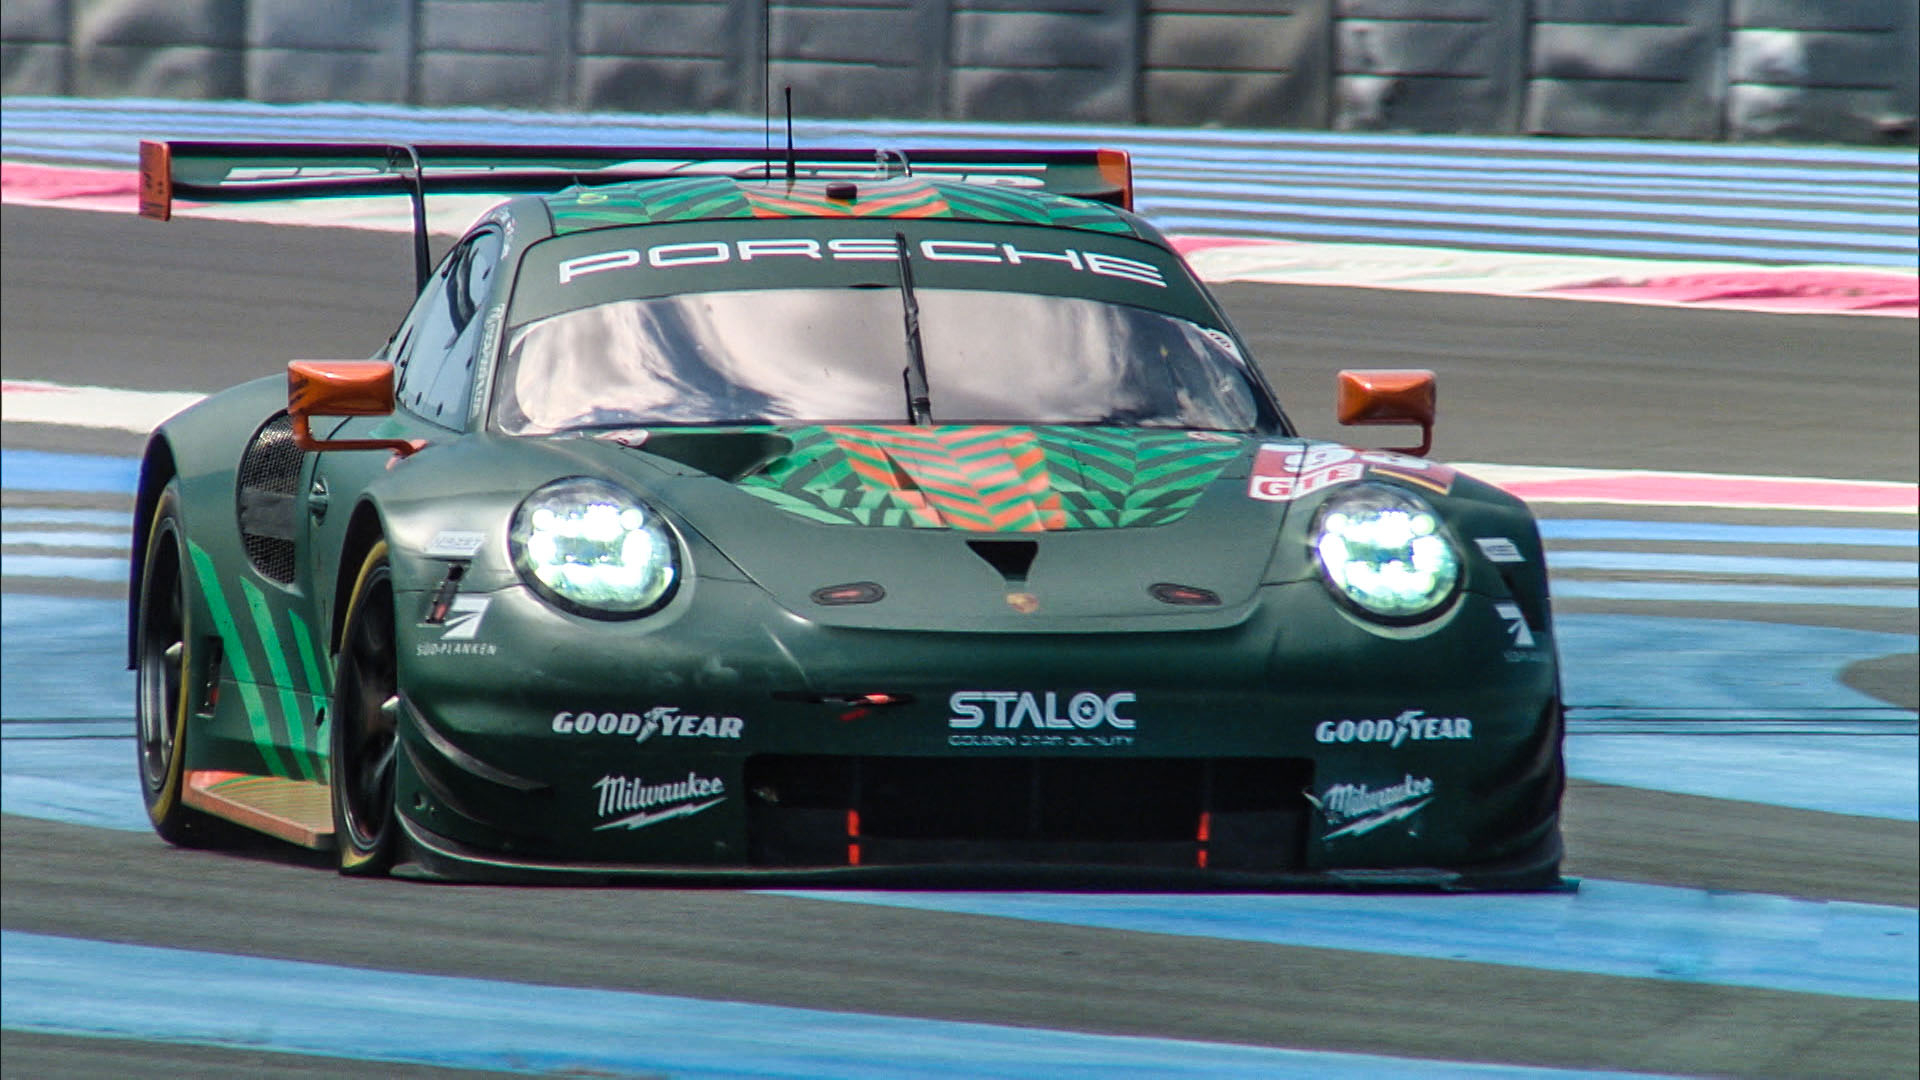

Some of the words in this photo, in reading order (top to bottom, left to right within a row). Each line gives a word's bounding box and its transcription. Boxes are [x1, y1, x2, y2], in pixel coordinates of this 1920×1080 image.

[560, 238, 1168, 288] PORSCHE
[1258, 468, 1355, 497] GTE
[552, 709, 744, 741] GOODYEAR
[949, 691, 1137, 729] STALOC
[1315, 712, 1473, 746] GOODYEAR
[592, 772, 726, 818] Milwaukee
